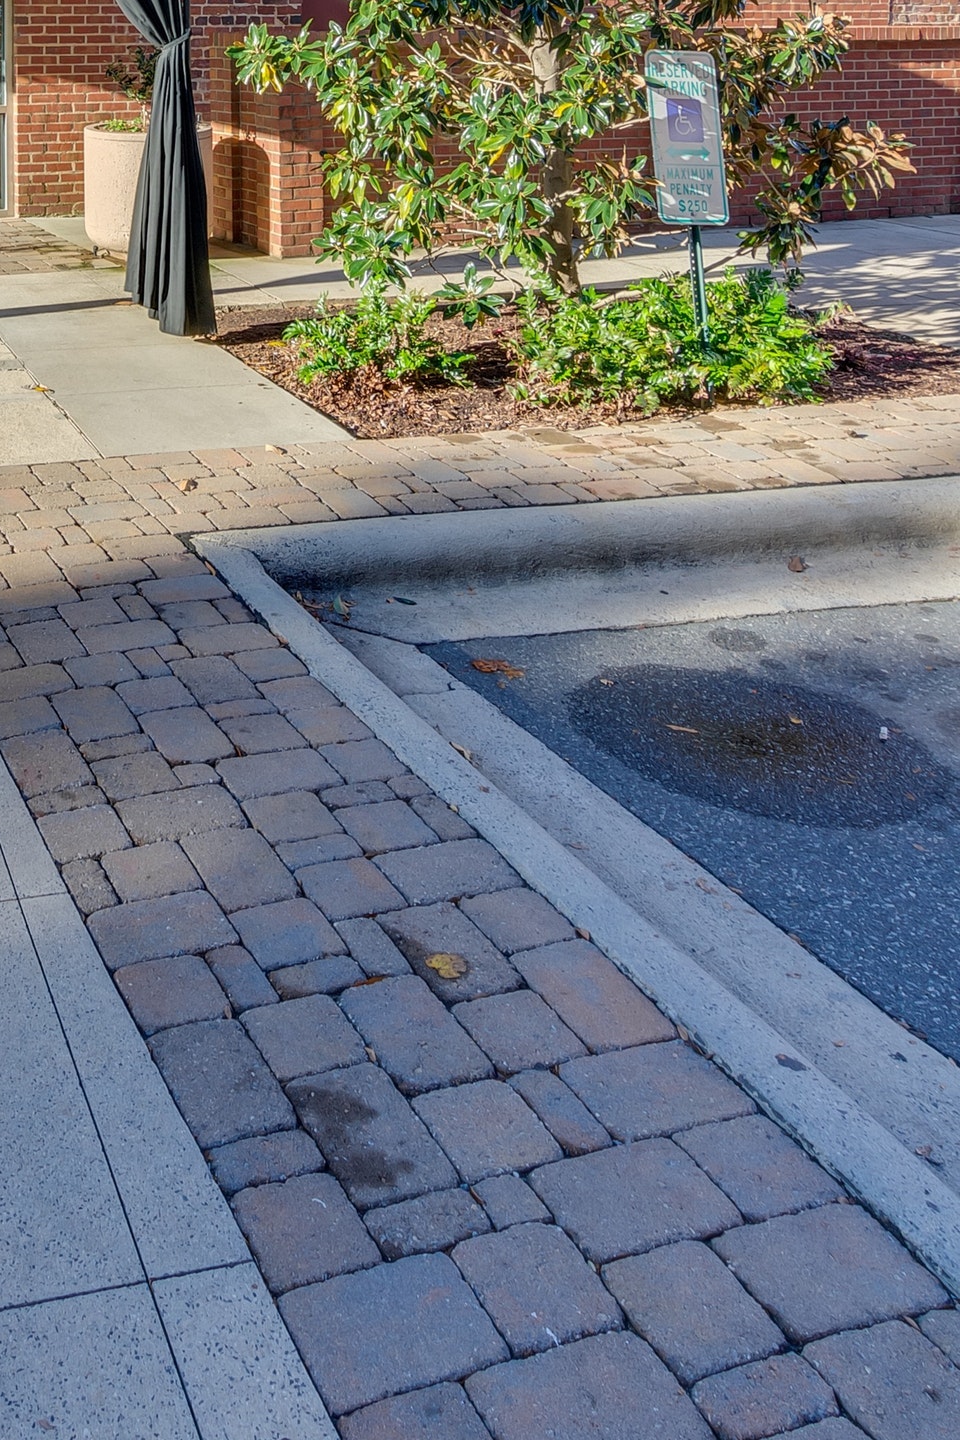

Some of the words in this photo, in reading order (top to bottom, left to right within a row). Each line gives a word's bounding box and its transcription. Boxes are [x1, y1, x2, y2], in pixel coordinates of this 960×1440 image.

[650, 61, 710, 79] RESERVED
[666, 167, 714, 180] MAXIMUM
[670, 183, 712, 196] PENALTY
[678, 199, 708, 212] $250
